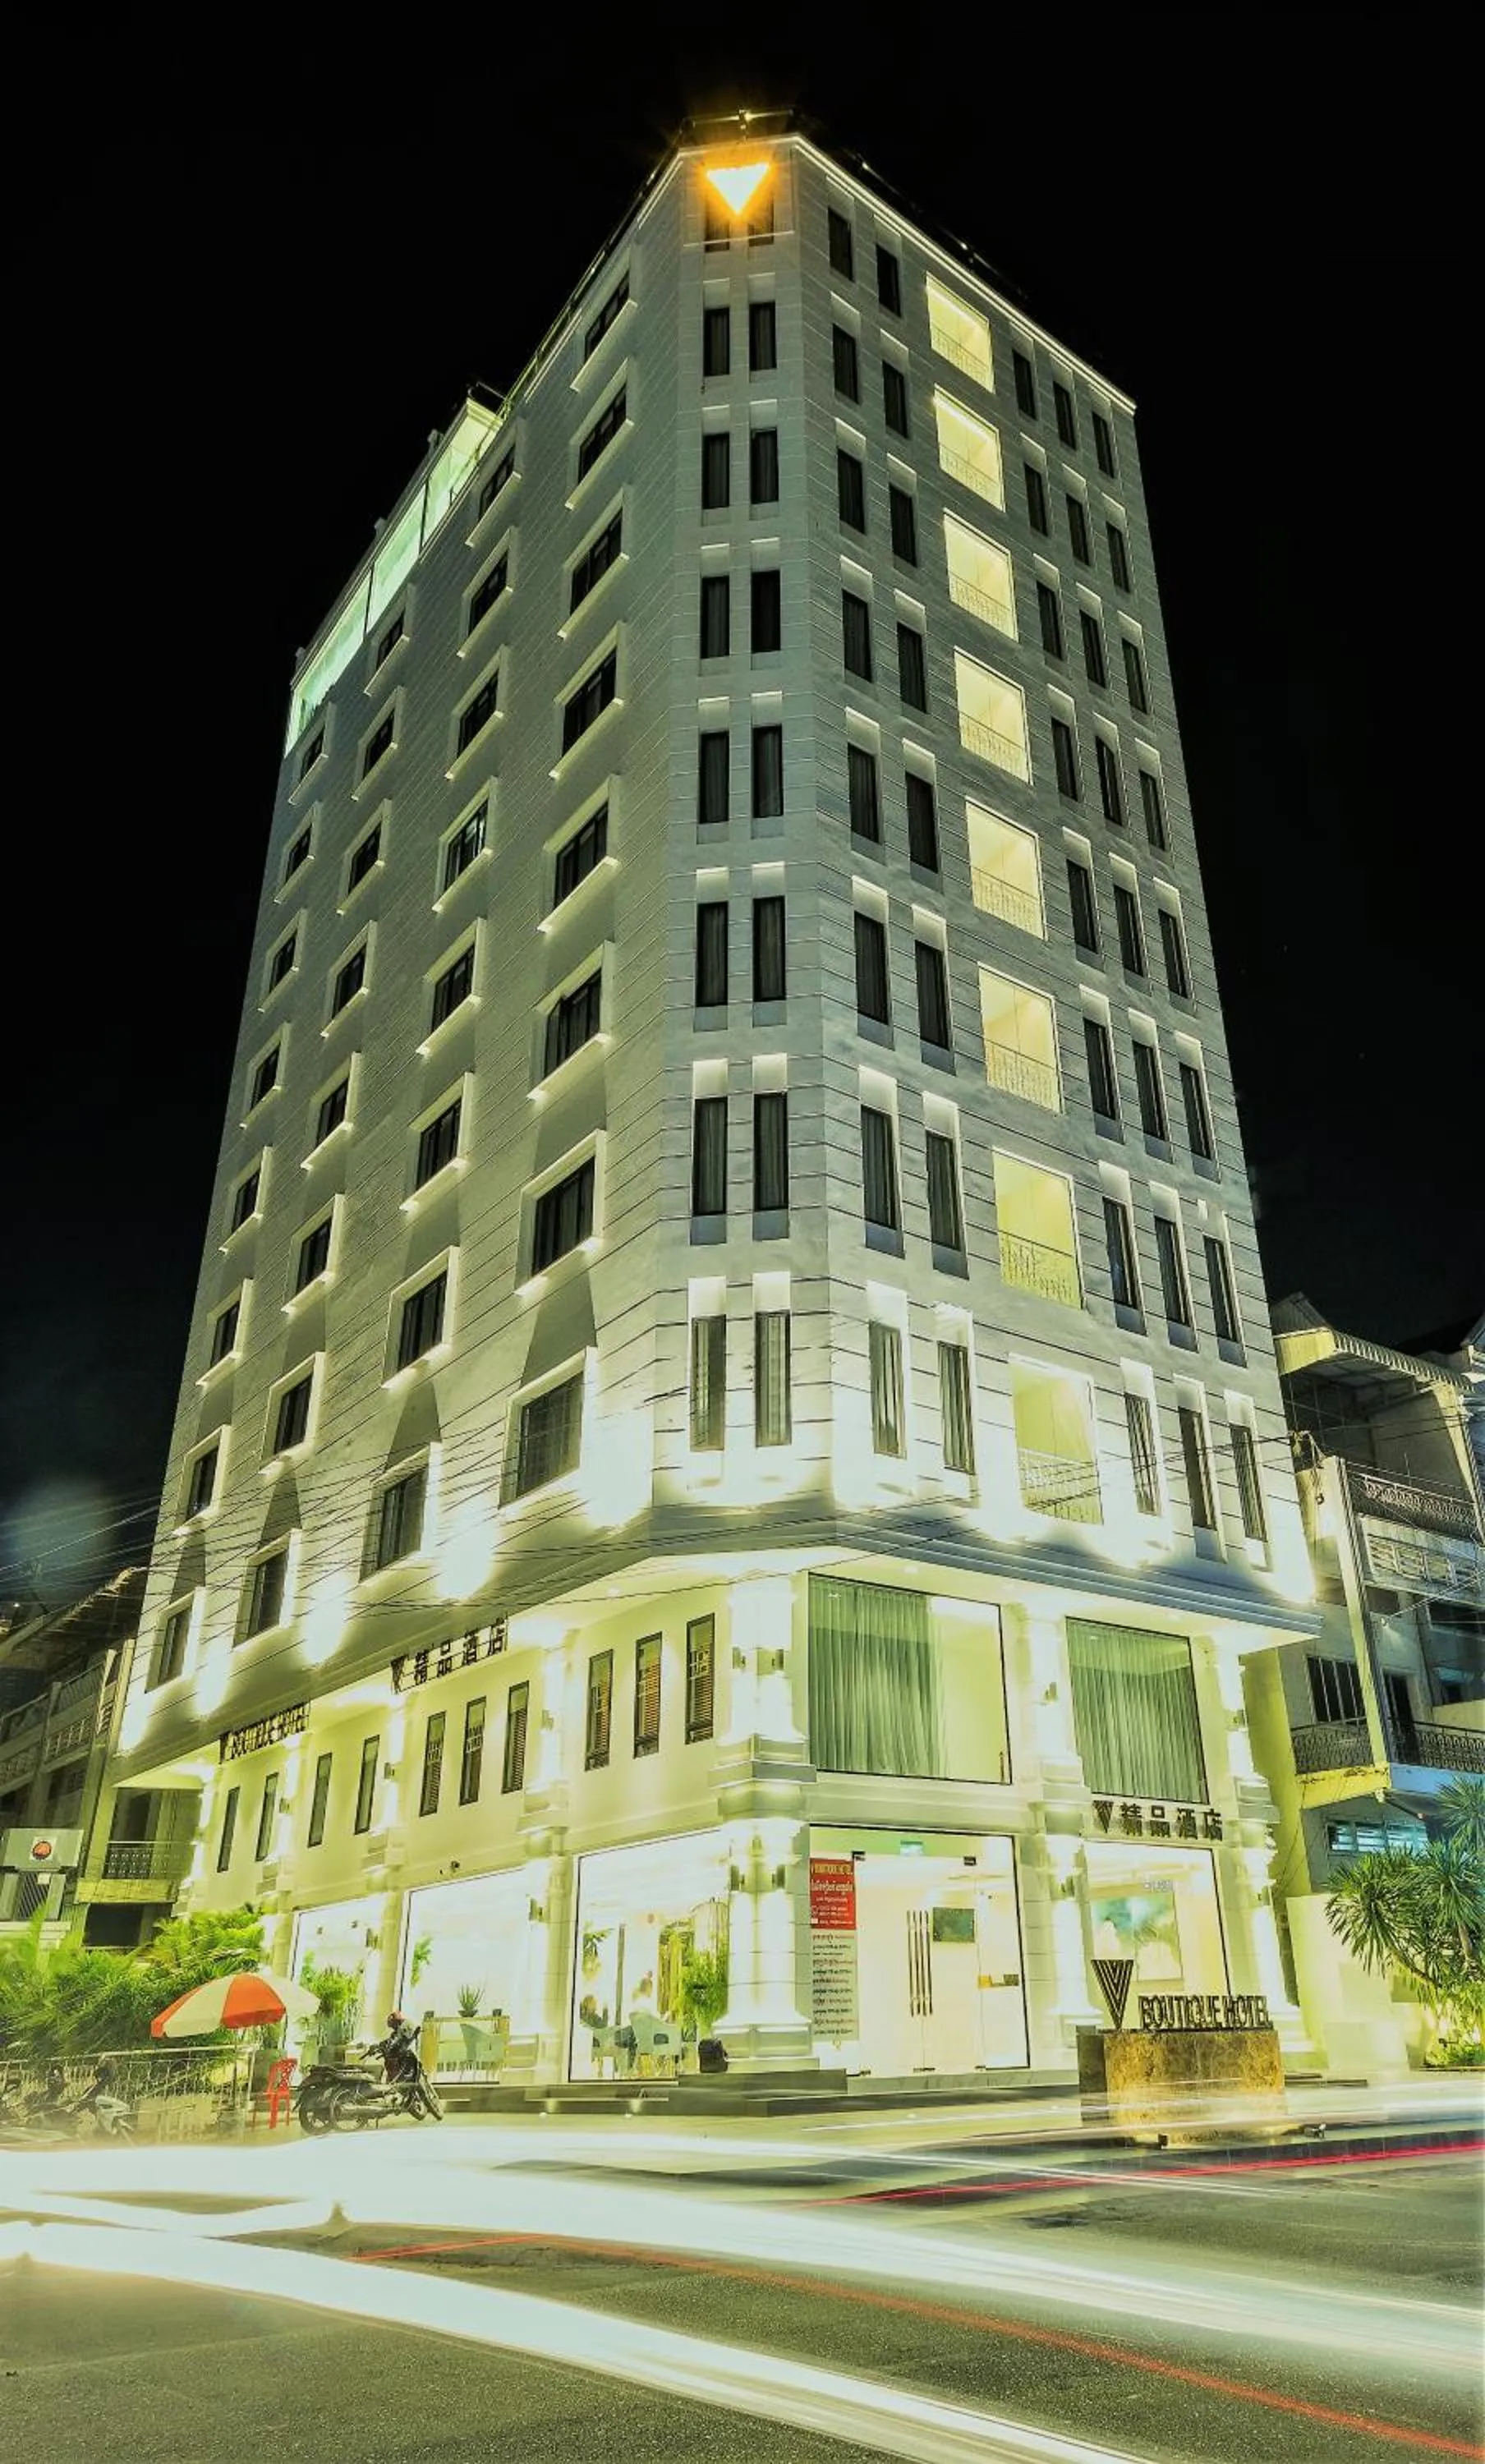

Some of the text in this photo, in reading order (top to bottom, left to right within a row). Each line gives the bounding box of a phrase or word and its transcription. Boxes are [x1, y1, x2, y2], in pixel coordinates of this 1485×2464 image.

[1119, 1802, 1223, 1841] 精品酒店
[1138, 1994, 1222, 2030] BOUTIQUE
[1222, 1994, 1271, 2029] HOTEL
